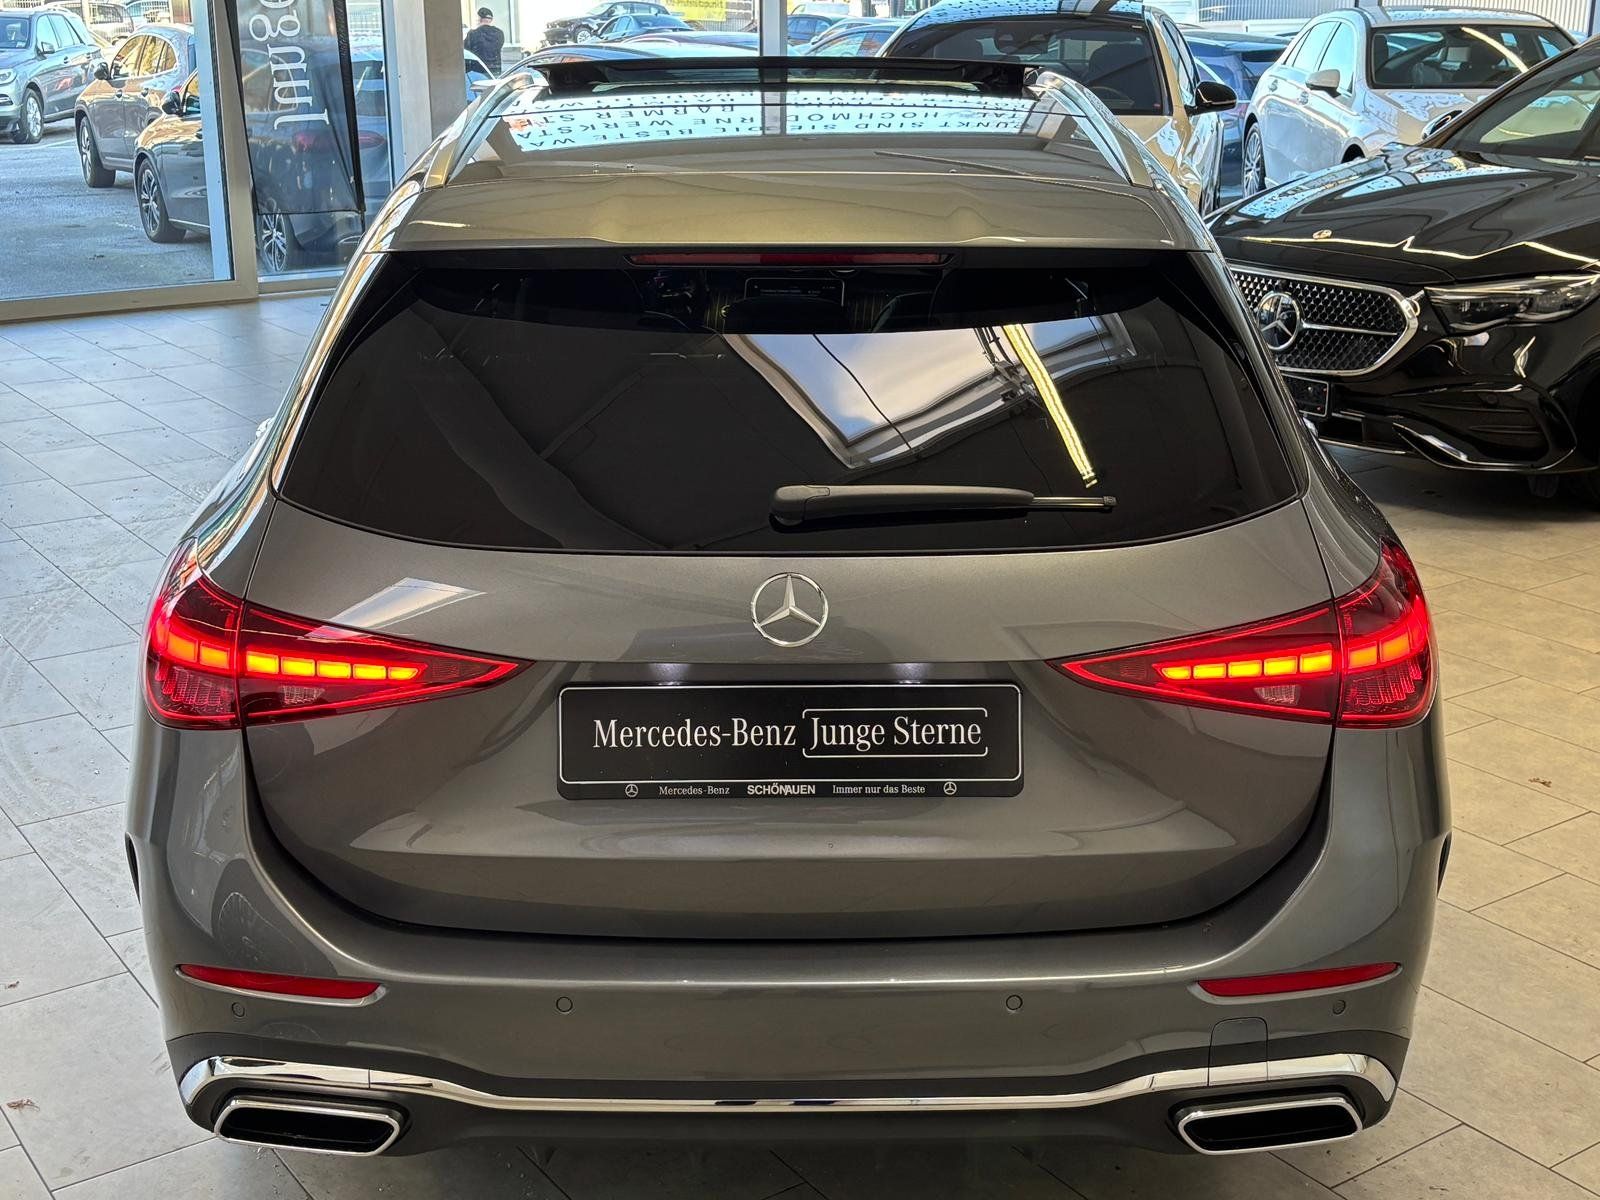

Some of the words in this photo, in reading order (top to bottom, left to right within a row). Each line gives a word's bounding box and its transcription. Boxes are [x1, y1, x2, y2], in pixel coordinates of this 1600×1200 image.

[593, 717, 796, 748] Mercedes-Benz
[809, 717, 885, 752] Junge
[893, 716, 981, 745] Sterne
[659, 785, 730, 796] Mercedes-Benz
[832, 784, 862, 794] Immer
[865, 786, 881, 794] nur
[883, 784, 899, 794] das
[901, 784, 926, 794] Beste
